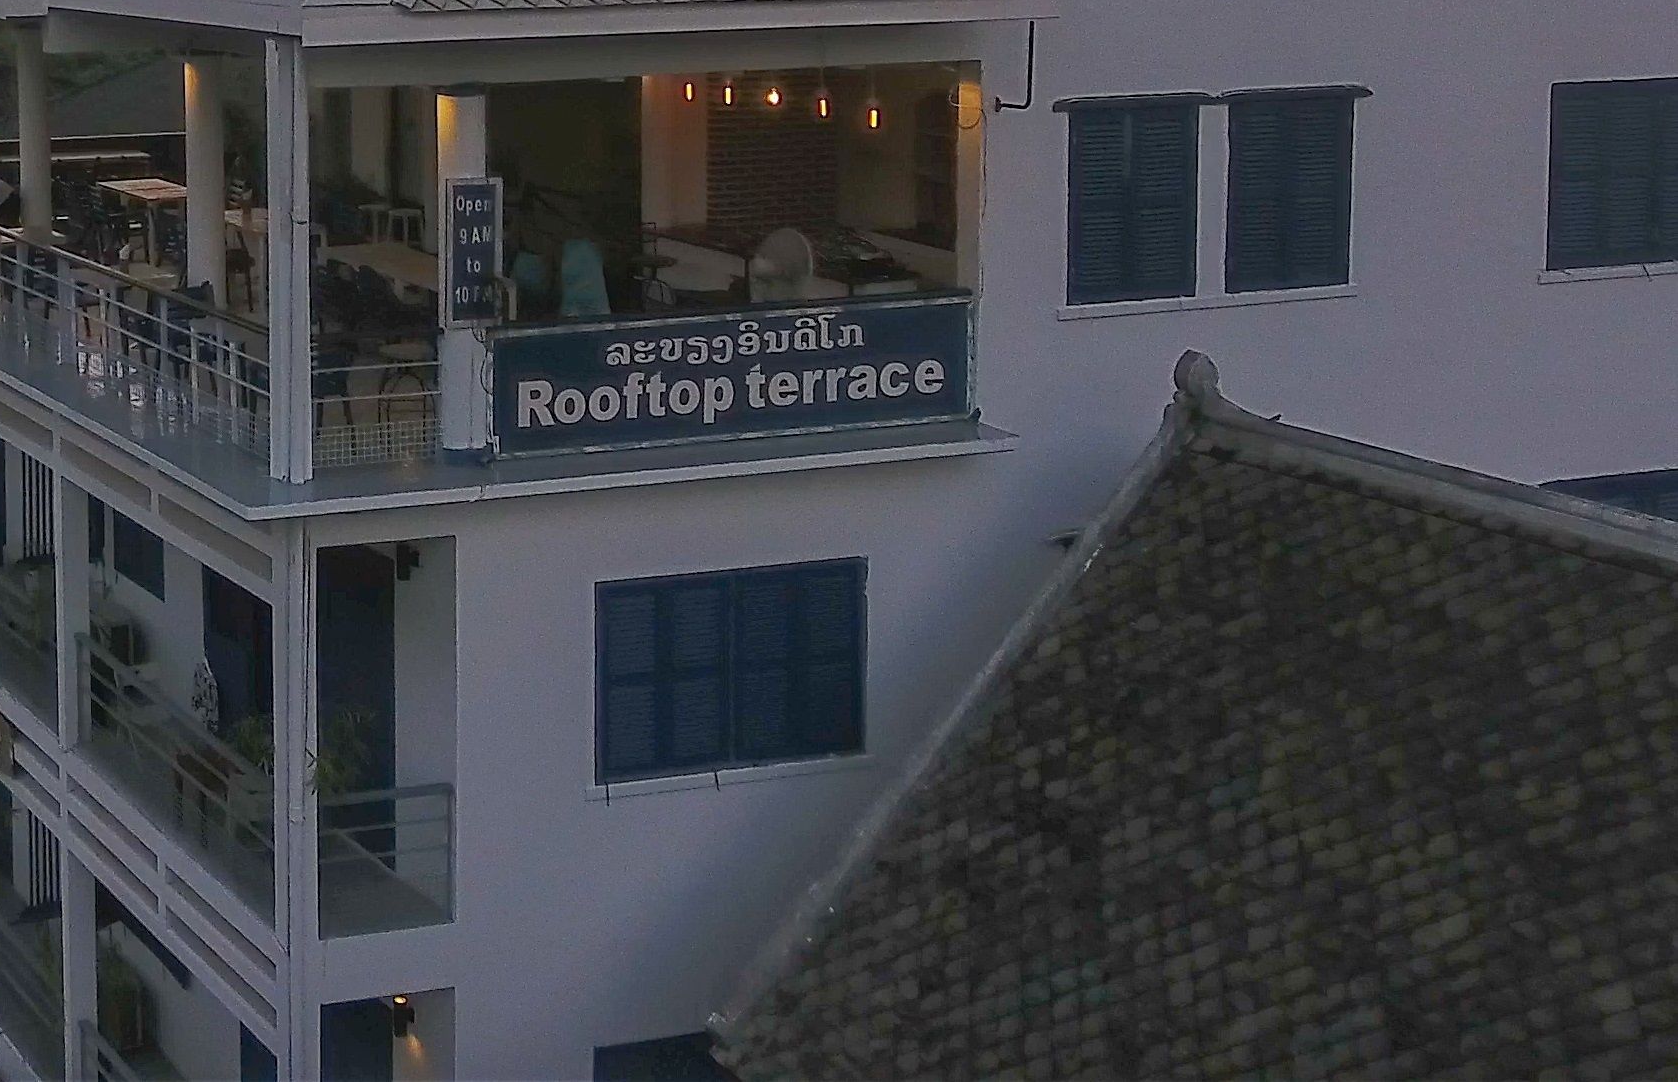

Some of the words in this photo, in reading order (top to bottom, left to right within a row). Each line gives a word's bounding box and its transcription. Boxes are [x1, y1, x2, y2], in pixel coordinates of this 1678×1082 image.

[456, 195, 492, 216] Open
[459, 228, 467, 244] 9
[466, 257, 481, 273] to
[455, 286, 469, 303] 10
[516, 371, 735, 428] Rooftop
[745, 359, 944, 409] terrace
